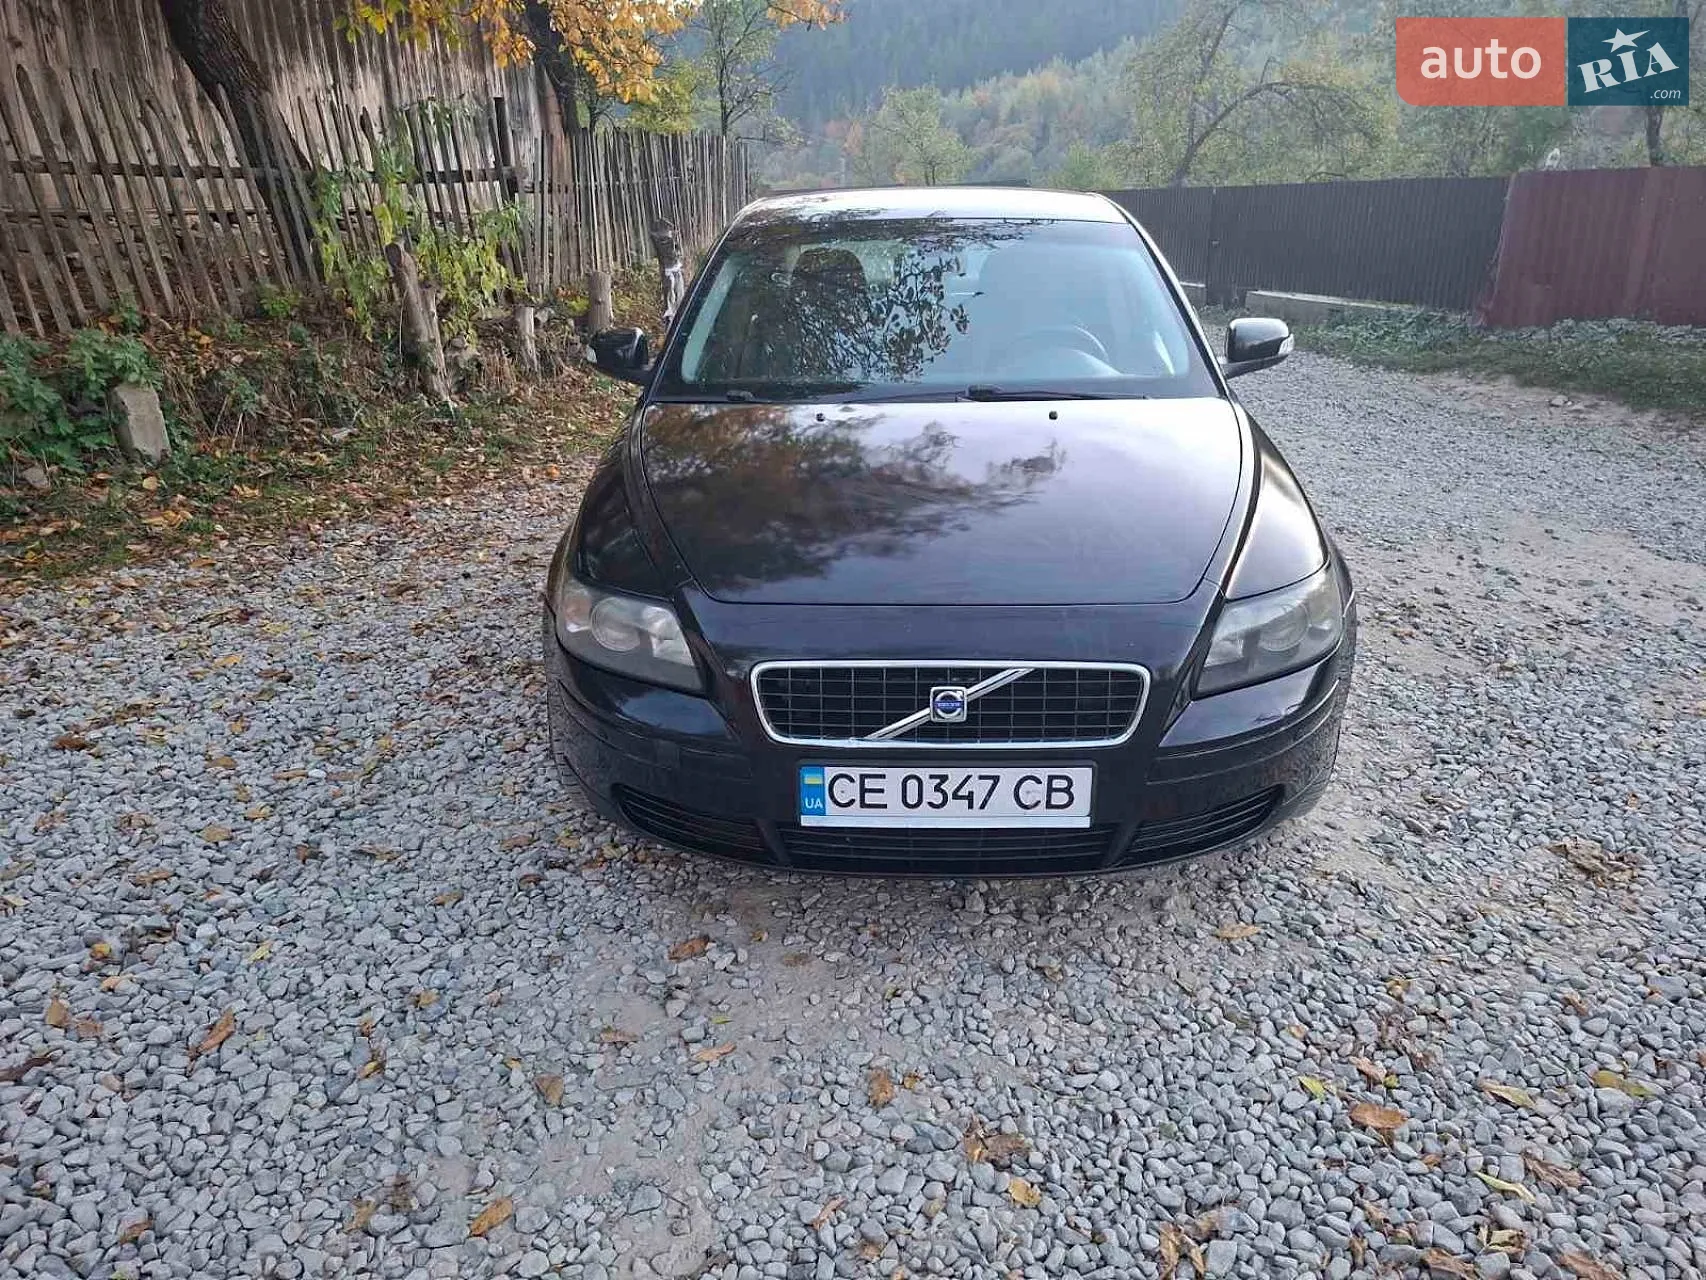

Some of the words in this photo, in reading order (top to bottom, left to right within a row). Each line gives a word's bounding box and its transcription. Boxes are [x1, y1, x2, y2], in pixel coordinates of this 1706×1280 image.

[827, 773, 888, 809] CE
[900, 774, 1001, 810] 0347
[1013, 774, 1075, 810] CB
[804, 799, 823, 809] UA
